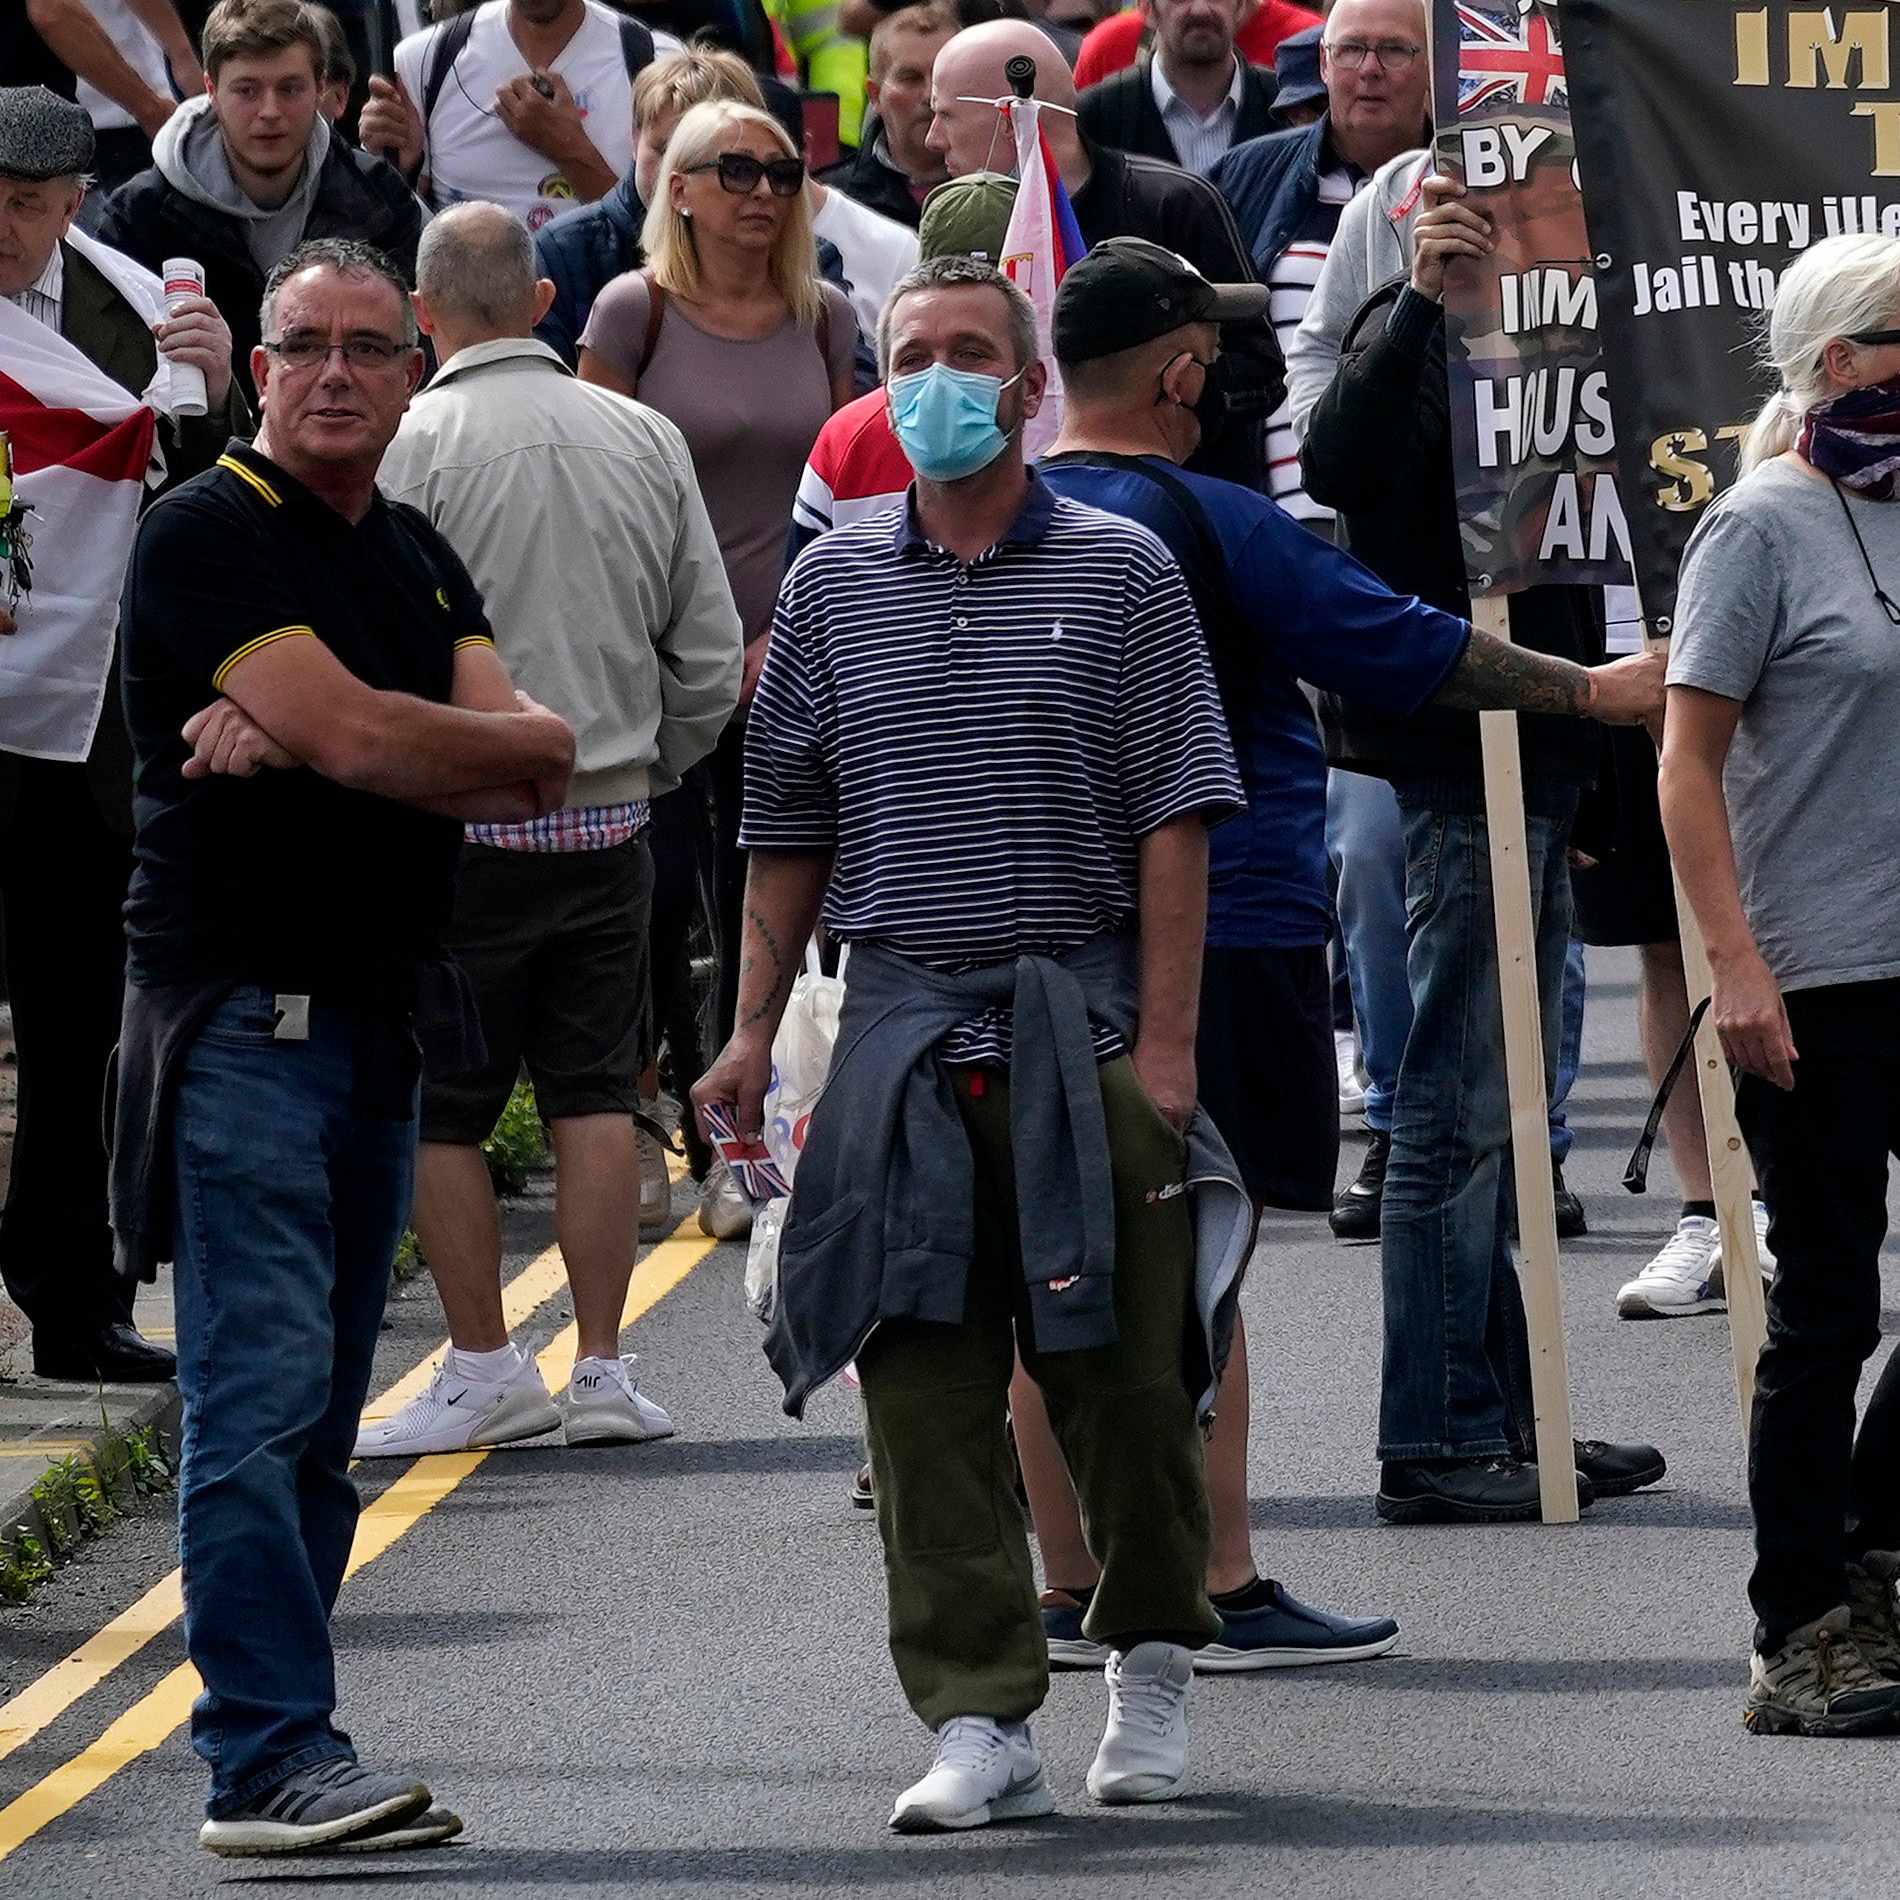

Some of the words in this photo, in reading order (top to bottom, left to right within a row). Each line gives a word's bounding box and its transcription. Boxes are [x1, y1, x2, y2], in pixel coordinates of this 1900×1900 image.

[1463, 124, 1553, 187] BY
[1677, 190, 1811, 250] Every
[1500, 267, 1599, 335] IMM
[1632, 254, 1719, 317] Jail
[1728, 259, 1788, 311] th
[1474, 368, 1616, 468] HOUS
[1538, 470, 1632, 562] AN
